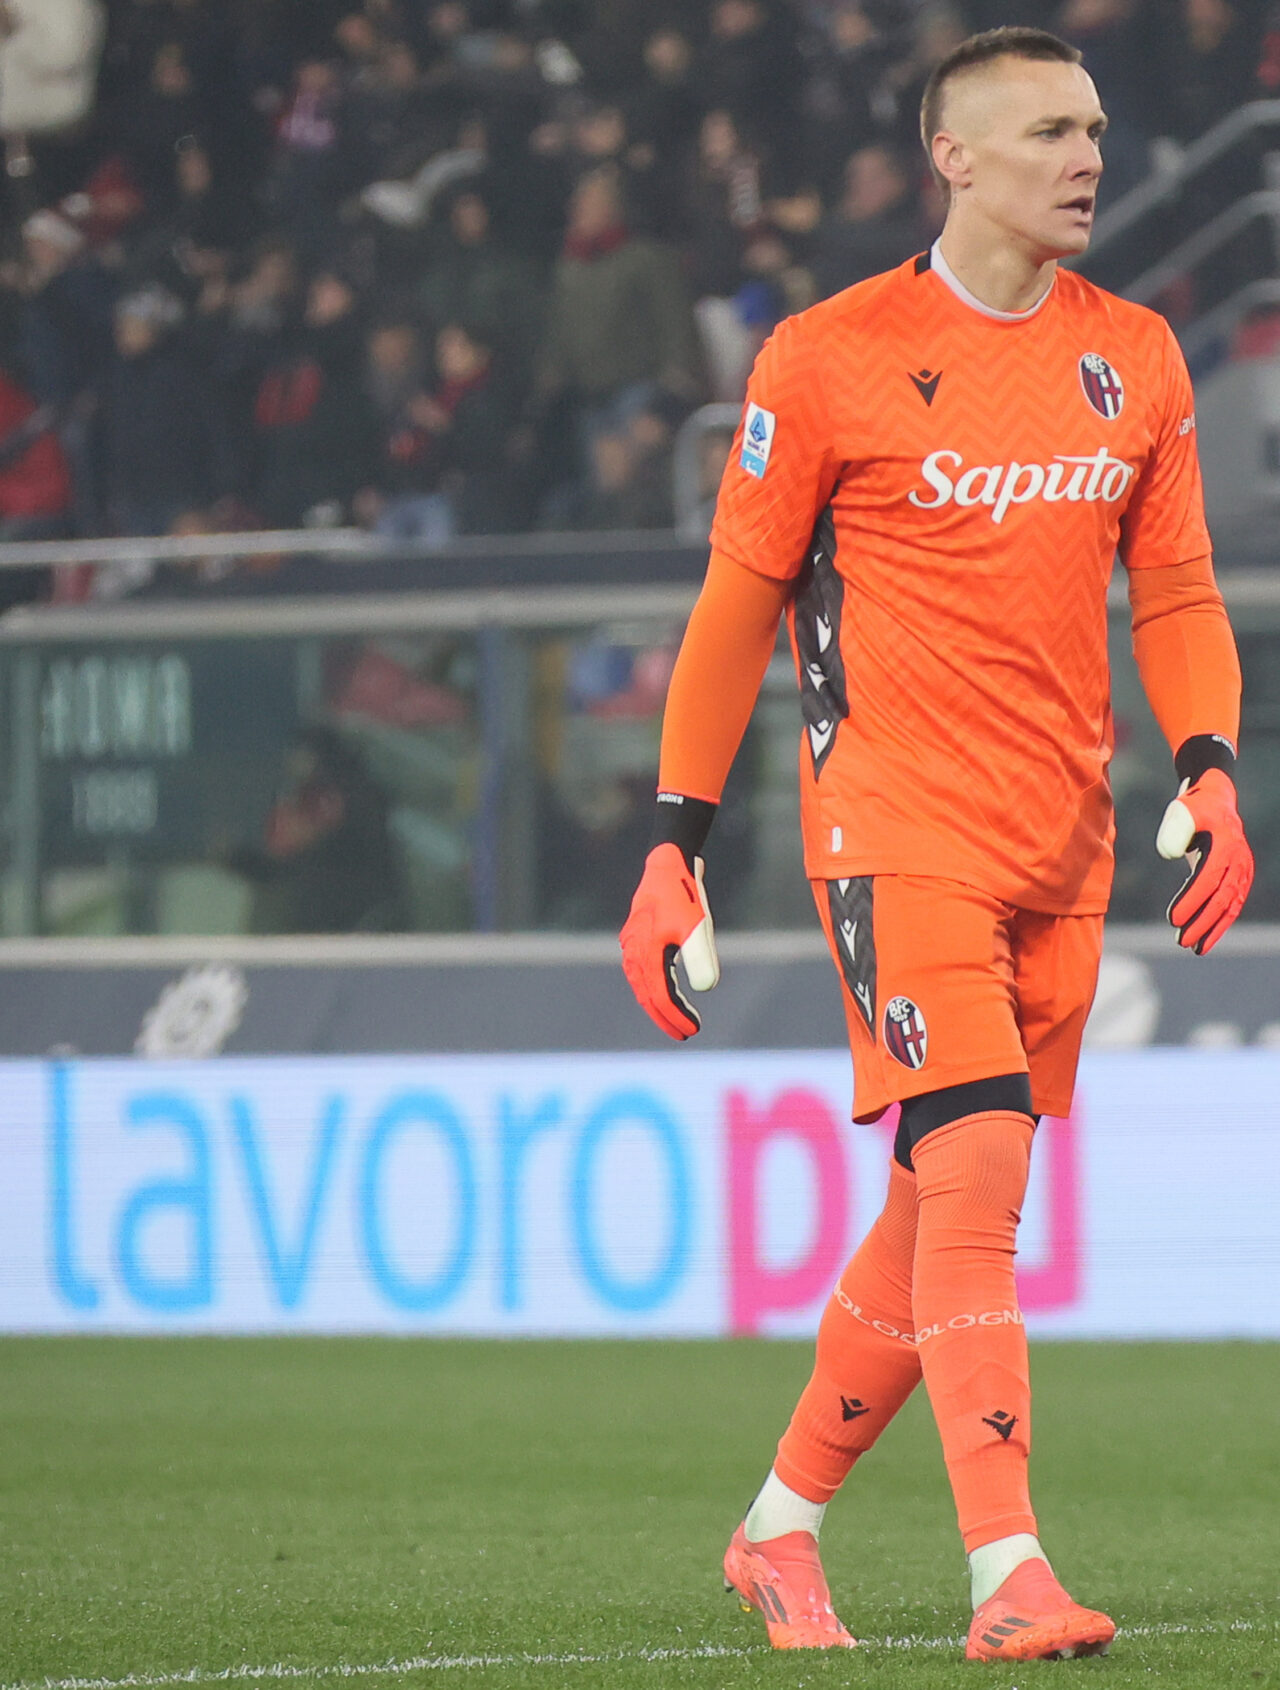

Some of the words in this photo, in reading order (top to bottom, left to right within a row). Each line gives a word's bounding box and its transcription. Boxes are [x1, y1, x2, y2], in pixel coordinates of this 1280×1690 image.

[1084, 354, 1106, 369] BFC
[908, 447, 1134, 524] Saputo
[888, 999, 911, 1018] BFC
